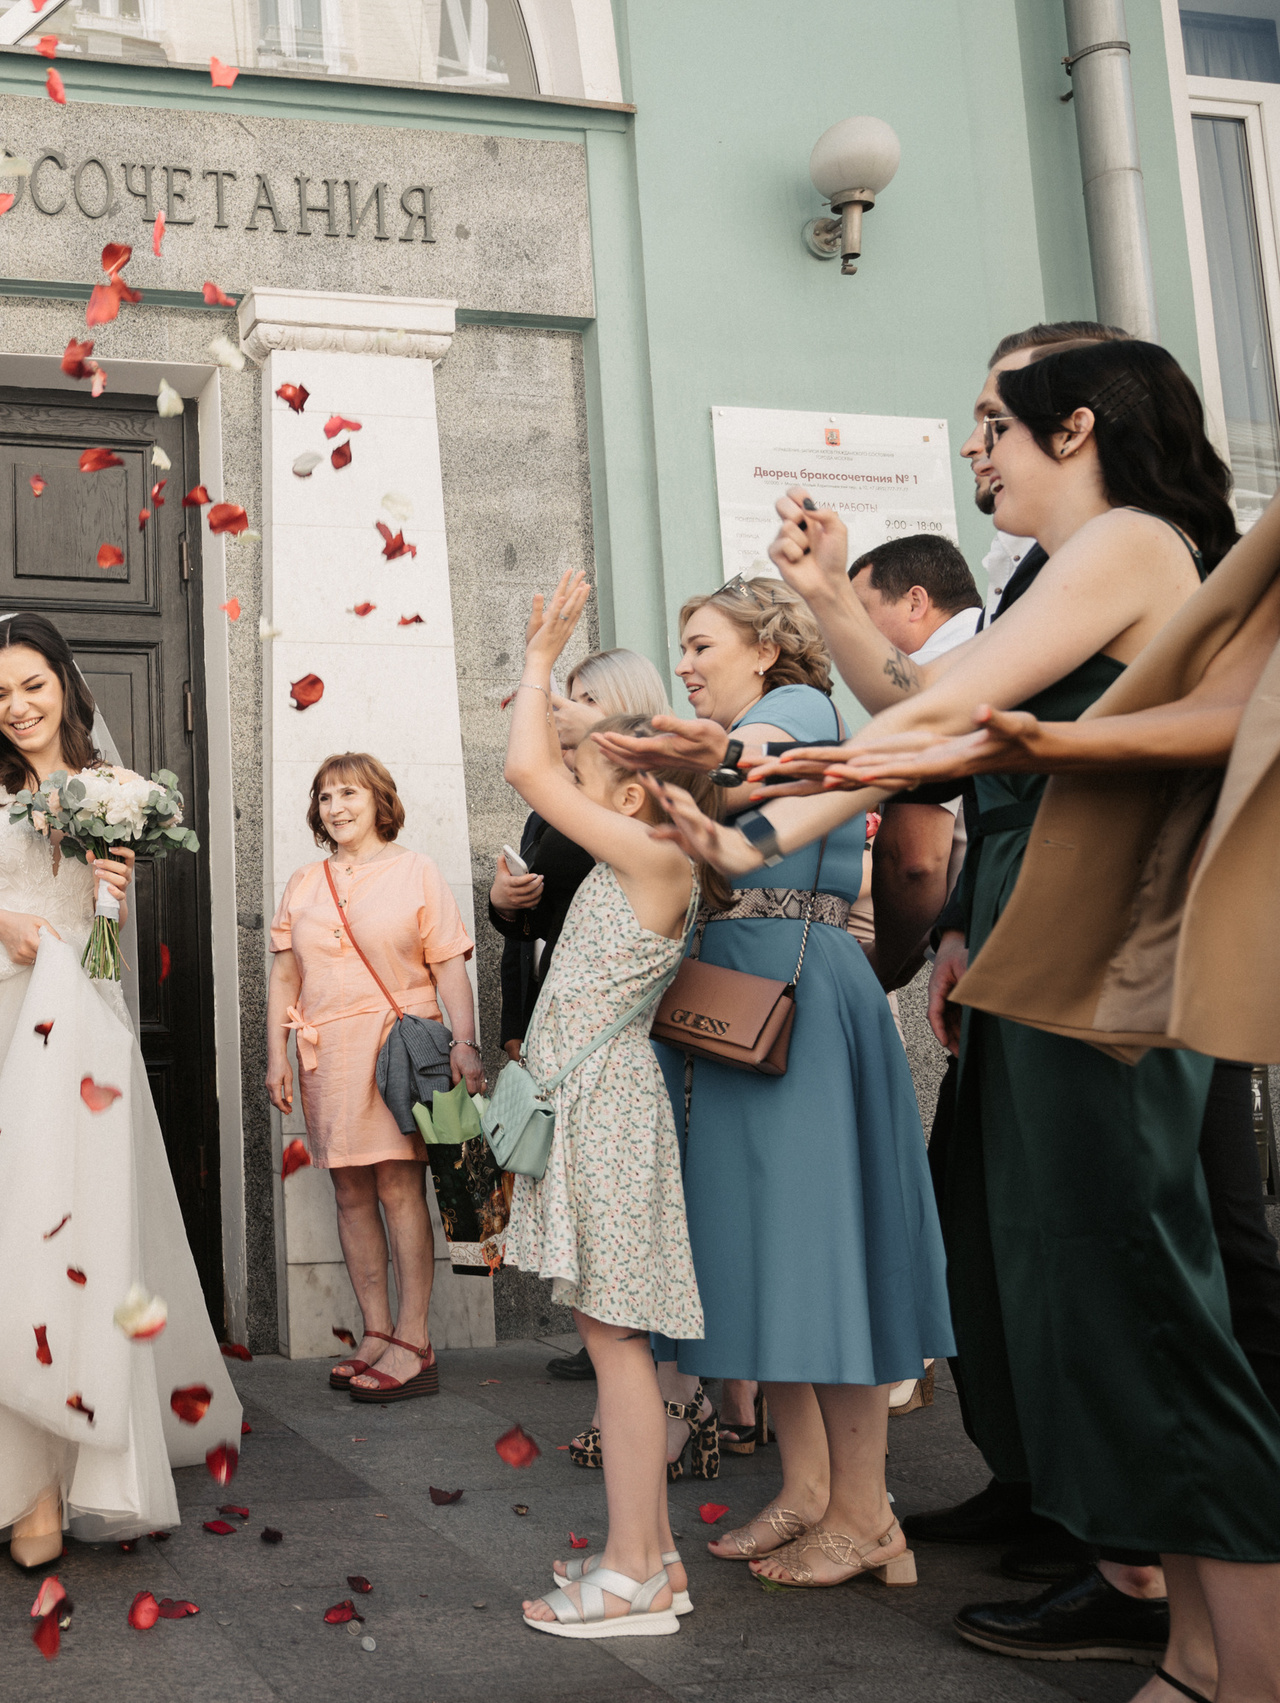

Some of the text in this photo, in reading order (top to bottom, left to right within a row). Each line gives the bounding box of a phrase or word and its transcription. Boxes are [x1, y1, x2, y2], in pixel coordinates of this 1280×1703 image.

[753, 466, 918, 485] Дворец бракосочетания № 1
[839, 502, 878, 513] РАБОТЫ
[885, 519, 907, 530] 9:00
[917, 520, 943, 532] 18:00
[671, 1009, 730, 1036] GUESS
